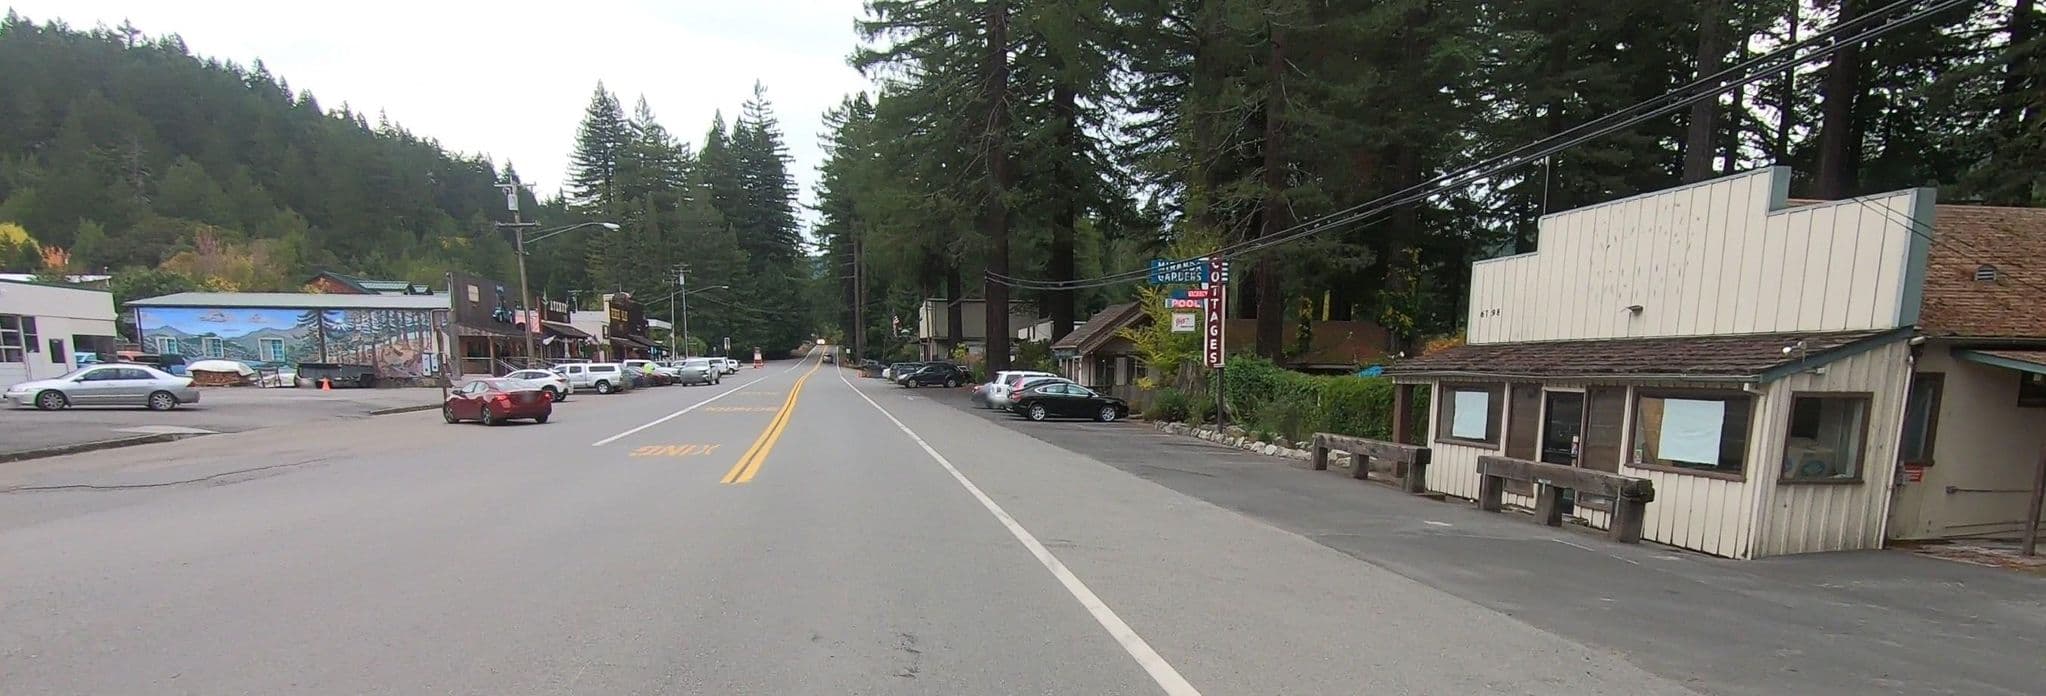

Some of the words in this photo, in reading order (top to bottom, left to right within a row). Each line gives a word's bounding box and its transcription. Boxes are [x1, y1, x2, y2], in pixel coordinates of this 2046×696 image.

[1157, 271, 1202, 282] GARDENS
[1171, 299, 1200, 308] POOL
[1210, 258, 1219, 363] COTTAGES
